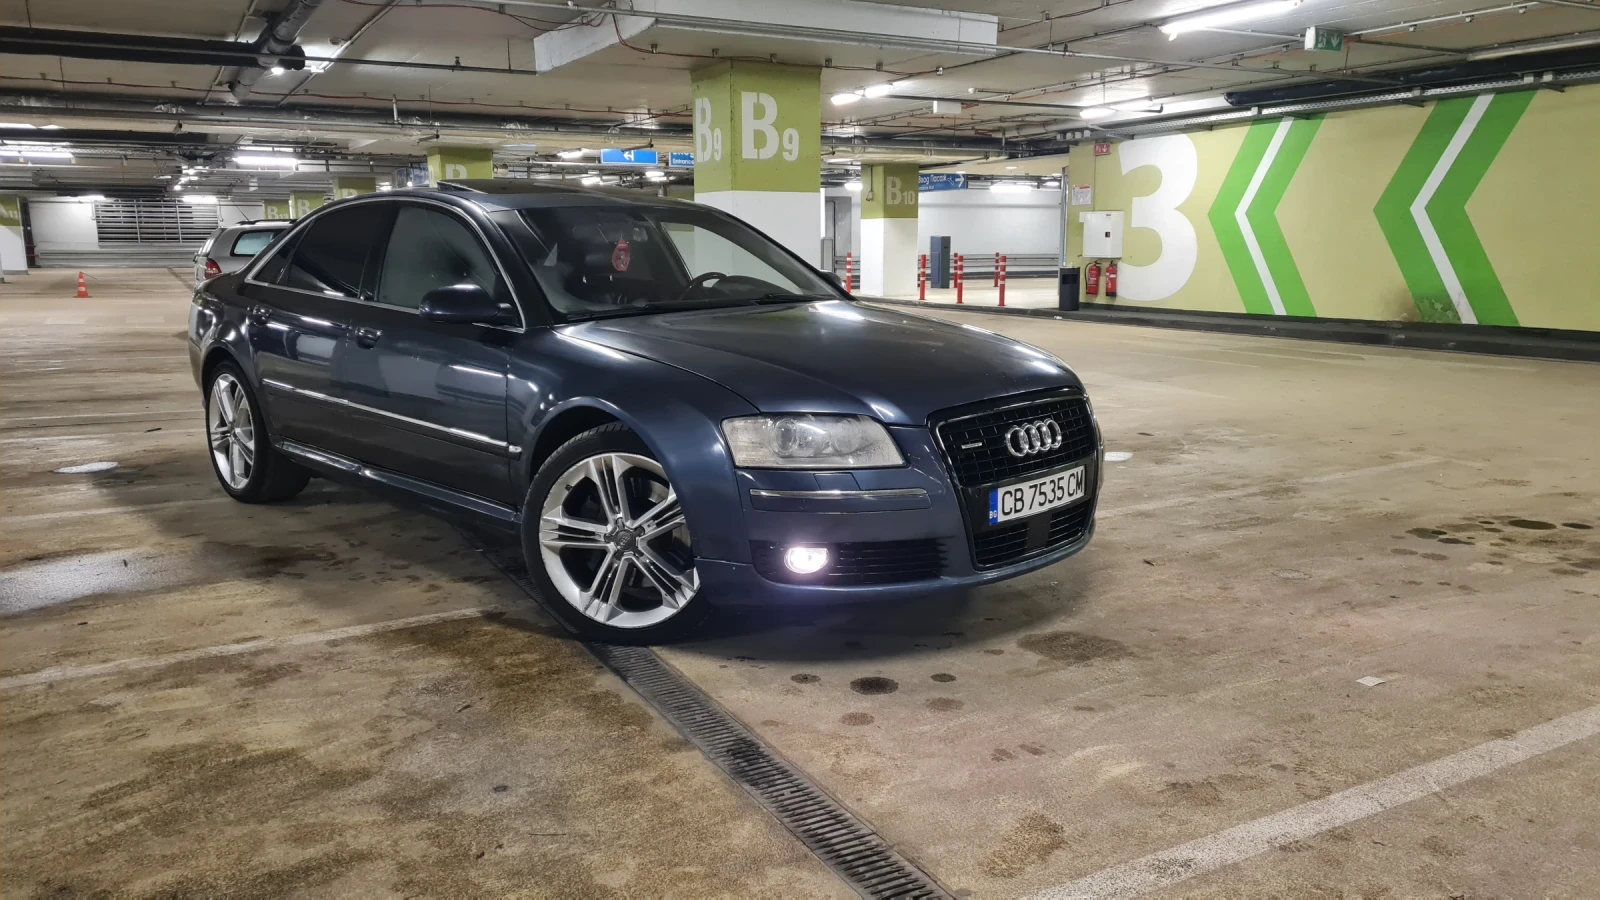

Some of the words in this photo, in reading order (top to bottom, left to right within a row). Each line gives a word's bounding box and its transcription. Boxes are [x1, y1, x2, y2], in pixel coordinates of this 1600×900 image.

[695, 97, 722, 163] B9
[741, 91, 800, 162] B9
[886, 176, 916, 205] B10
[1117, 133, 1198, 301] 3
[989, 511, 998, 519] BG
[1002, 487, 1025, 516] CB
[1029, 476, 1065, 510] 7535
[1067, 469, 1084, 497] CM
